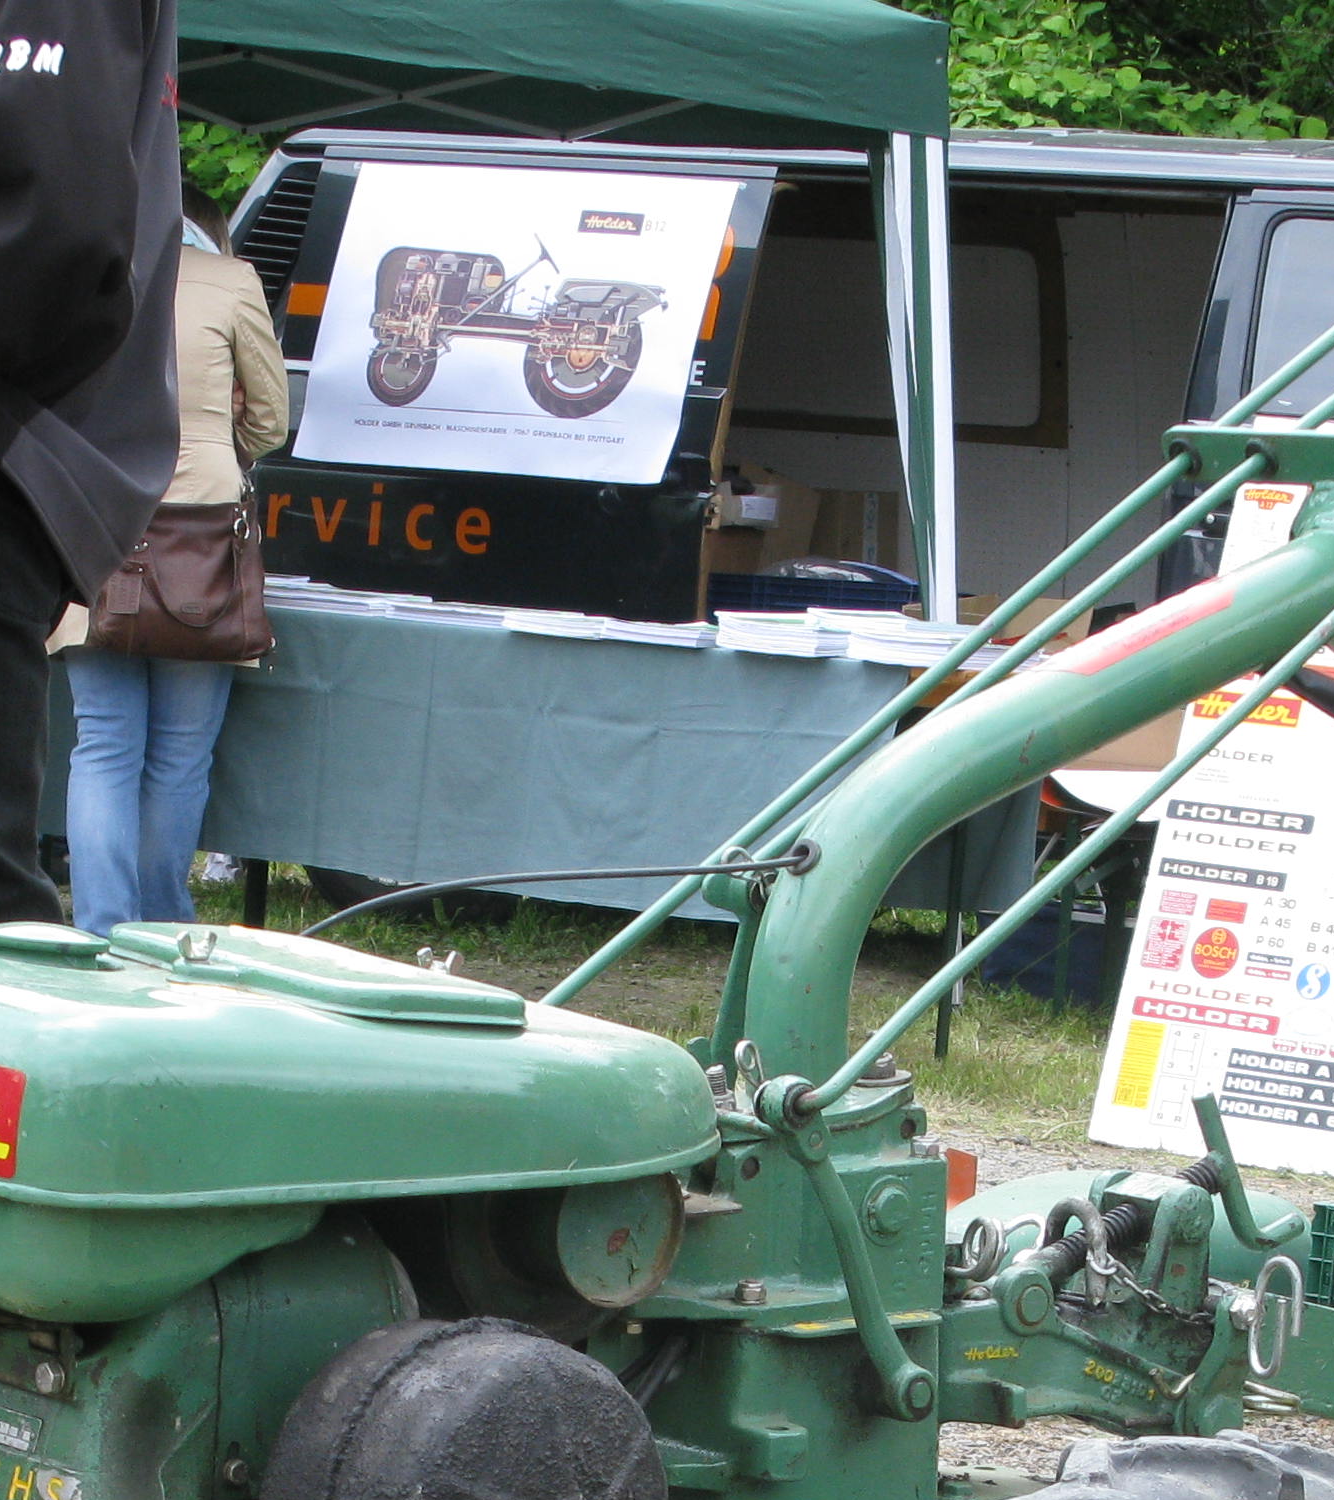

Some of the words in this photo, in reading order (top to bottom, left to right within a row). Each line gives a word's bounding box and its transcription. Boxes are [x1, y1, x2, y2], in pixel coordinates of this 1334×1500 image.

[585, 215, 637, 231] Holder
[1245, 489, 1292, 504] Holder
[1196, 693, 1297, 724] Hoer
[1208, 747, 1274, 765] OLDER
[1177, 803, 1306, 832] HOLDER
[1171, 829, 1298, 856] HOLDER
[1163, 862, 1249, 884] HOLDER
[1256, 873, 1265, 886] B
[1266, 875, 1280, 888] 19
[1264, 896, 1274, 907] A
[1279, 898, 1297, 910] 30
[1260, 916, 1270, 927] A
[1274, 917, 1292, 930] 45
[1310, 922, 1321, 933] B
[1194, 943, 1237, 961] BOSCH
[1268, 937, 1285, 949] 60
[1307, 942, 1317, 954] B
[1149, 979, 1274, 1009] HOLDER
[1141, 1000, 1271, 1034] HOLDER
[1232, 1052, 1309, 1076] HOLDER
[1315, 1065, 1331, 1079] A
[1226, 1076, 1303, 1099] HOLDER
[1310, 1088, 1325, 1102] A
[1220, 1099, 1299, 1123] HOLDER
[1304, 1112, 1319, 1126] A
[964, 1346, 1019, 1362] Holder
